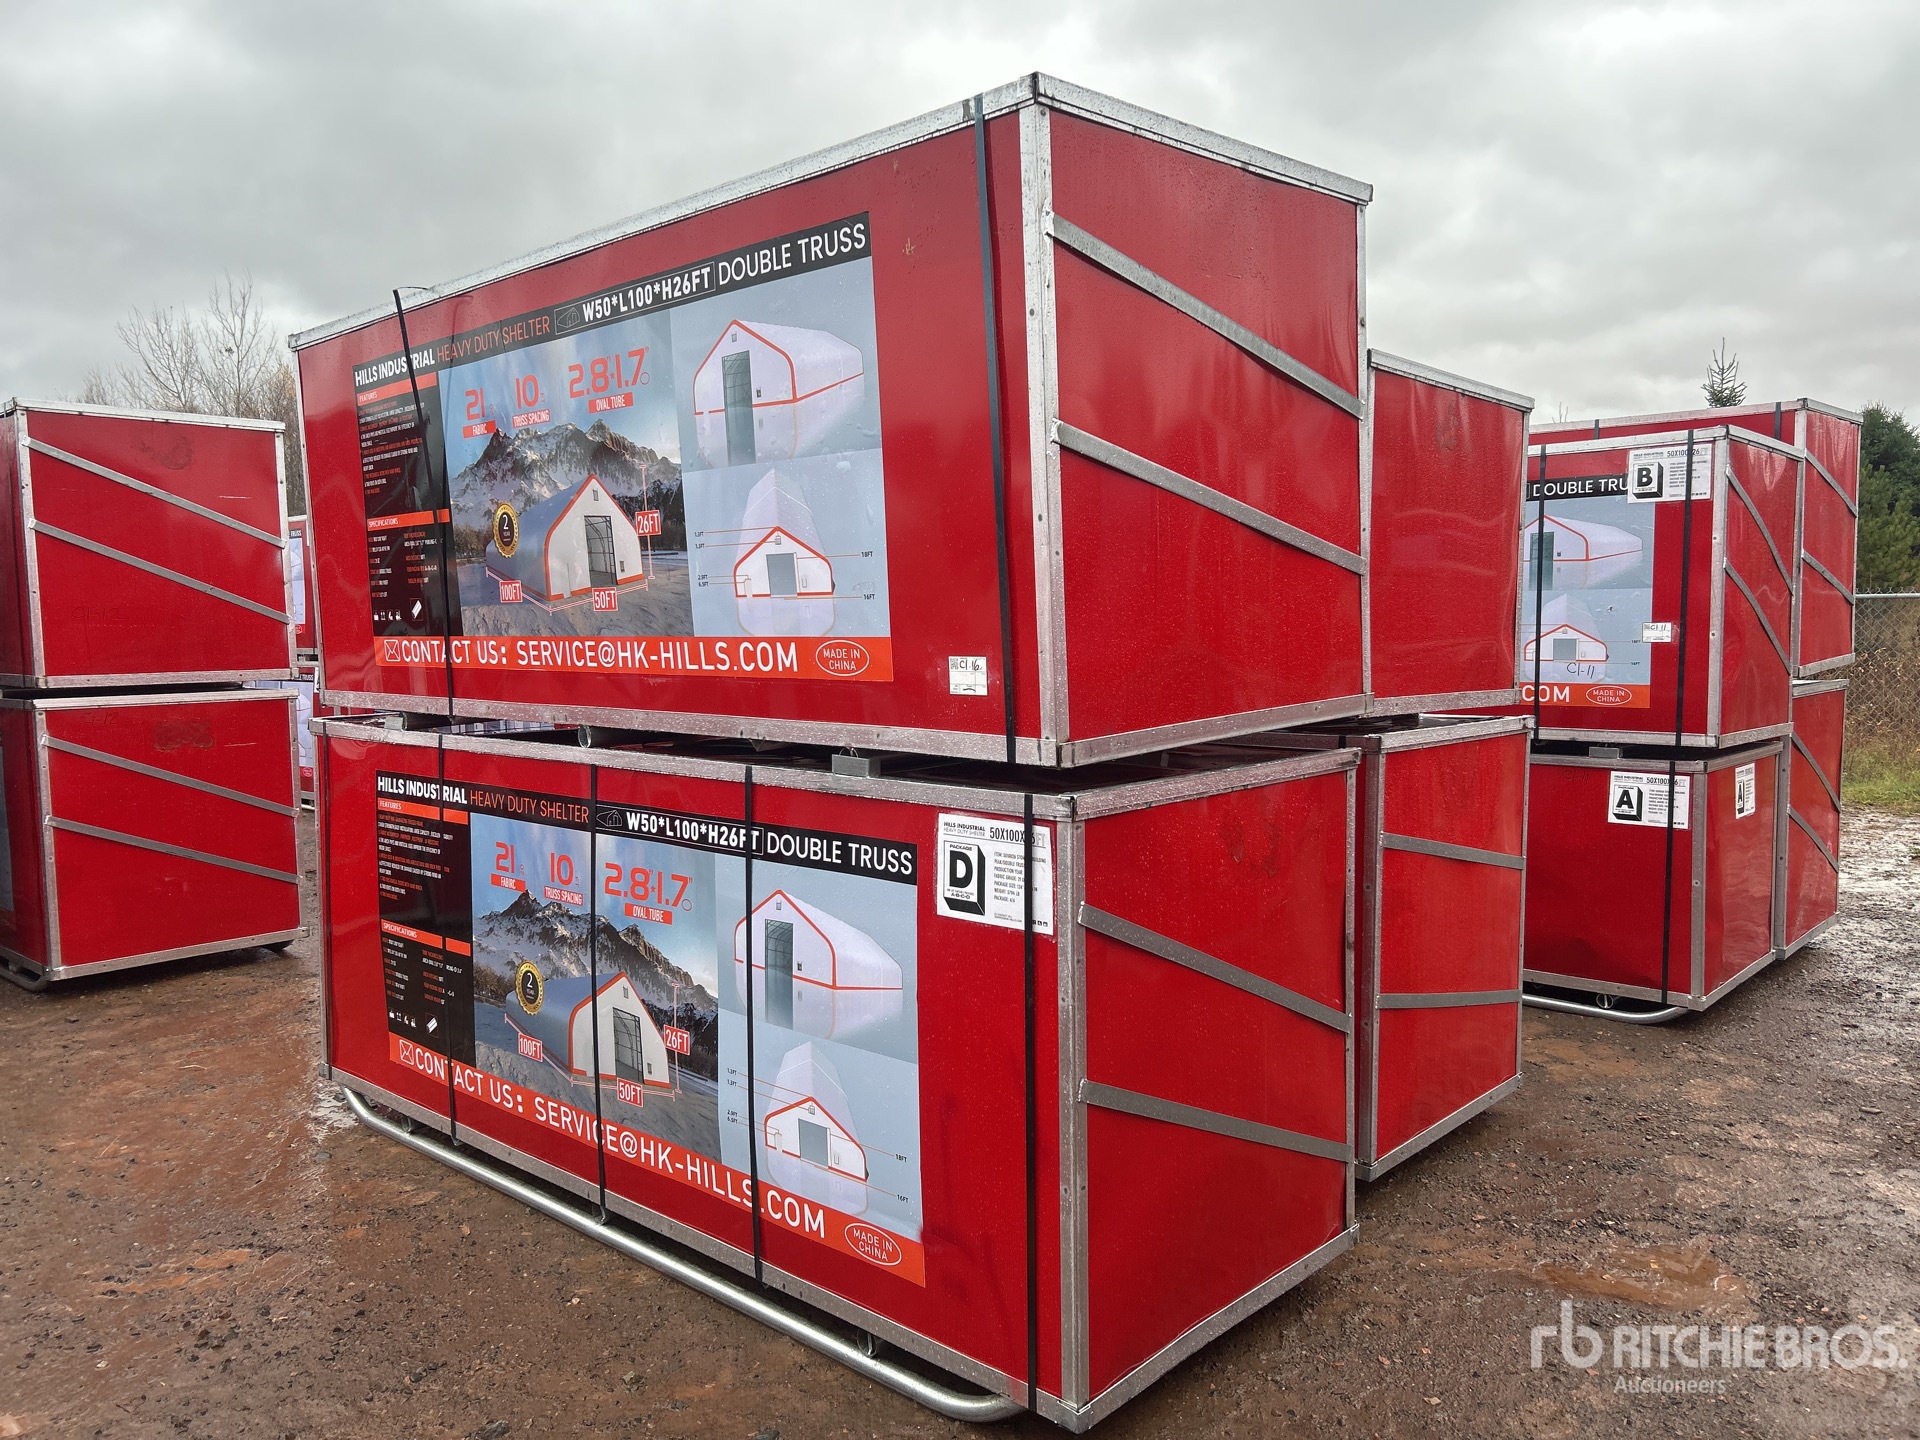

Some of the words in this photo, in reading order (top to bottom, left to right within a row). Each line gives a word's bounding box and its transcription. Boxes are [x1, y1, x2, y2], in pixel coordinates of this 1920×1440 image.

[355, 366, 378, 386] HILLS
[379, 348, 435, 380] INDUSRIAL
[436, 338, 472, 363] HEAVY
[474, 329, 501, 353] DUTY
[502, 315, 551, 345] SHELTER
[718, 243, 792, 286] DOUBLE
[797, 223, 866, 263] TRUSS
[515, 374, 540, 409] 10
[465, 387, 486, 421] 21
[596, 396, 610, 412] OVAL
[610, 394, 626, 410] TUBE
[1636, 467, 1653, 487] B
[1533, 480, 1594, 497] DOUBLE
[1599, 478, 1629, 492] TRU
[502, 514, 509, 530] 2
[637, 512, 661, 534] 26FT
[501, 581, 522, 601] 100FT
[594, 588, 616, 609] 50FT
[477, 640, 507, 665] US:
[517, 640, 798, 672] SERVICE@HK-HILLS.COM
[823, 648, 849, 659] MADE
[850, 649, 861, 659] IN
[829, 659, 856, 671] CHINA
[1616, 789, 1634, 809] A
[1738, 784, 1743, 803] A
[379, 800, 401, 810] FEATURES
[378, 777, 405, 794] HILLS
[470, 790, 505, 810] HEAVY
[508, 795, 537, 814] DUTY
[540, 800, 589, 824] SHELTER
[767, 834, 842, 864] DOUBLE
[848, 842, 913, 875] TRUSS
[957, 823, 985, 831] INDUSTRIAL
[495, 841, 515, 873] 21
[550, 852, 574, 886] 10
[949, 849, 973, 889] D
[545, 886, 560, 899] TRUSS
[561, 890, 583, 905] SPACING
[632, 905, 647, 919] OVAL
[648, 908, 664, 922] TUBE
[383, 922, 418, 938] SPECIFICATIONS
[526, 972, 533, 988] 2
[519, 1037, 541, 1059] 100FT
[665, 1029, 689, 1053] 26FT
[618, 1083, 642, 1104] 50FT
[415, 1047, 483, 1096] CONACT
[489, 1078, 523, 1113] US:
[534, 1096, 825, 1239] SERVICE@HK-HILLS.COM
[895, 1153, 907, 1163] 18FT
[897, 1194, 909, 1203] 16FT
[853, 1227, 879, 1247] MADE
[882, 1239, 893, 1252] IN
[858, 1241, 888, 1262] CHINA
